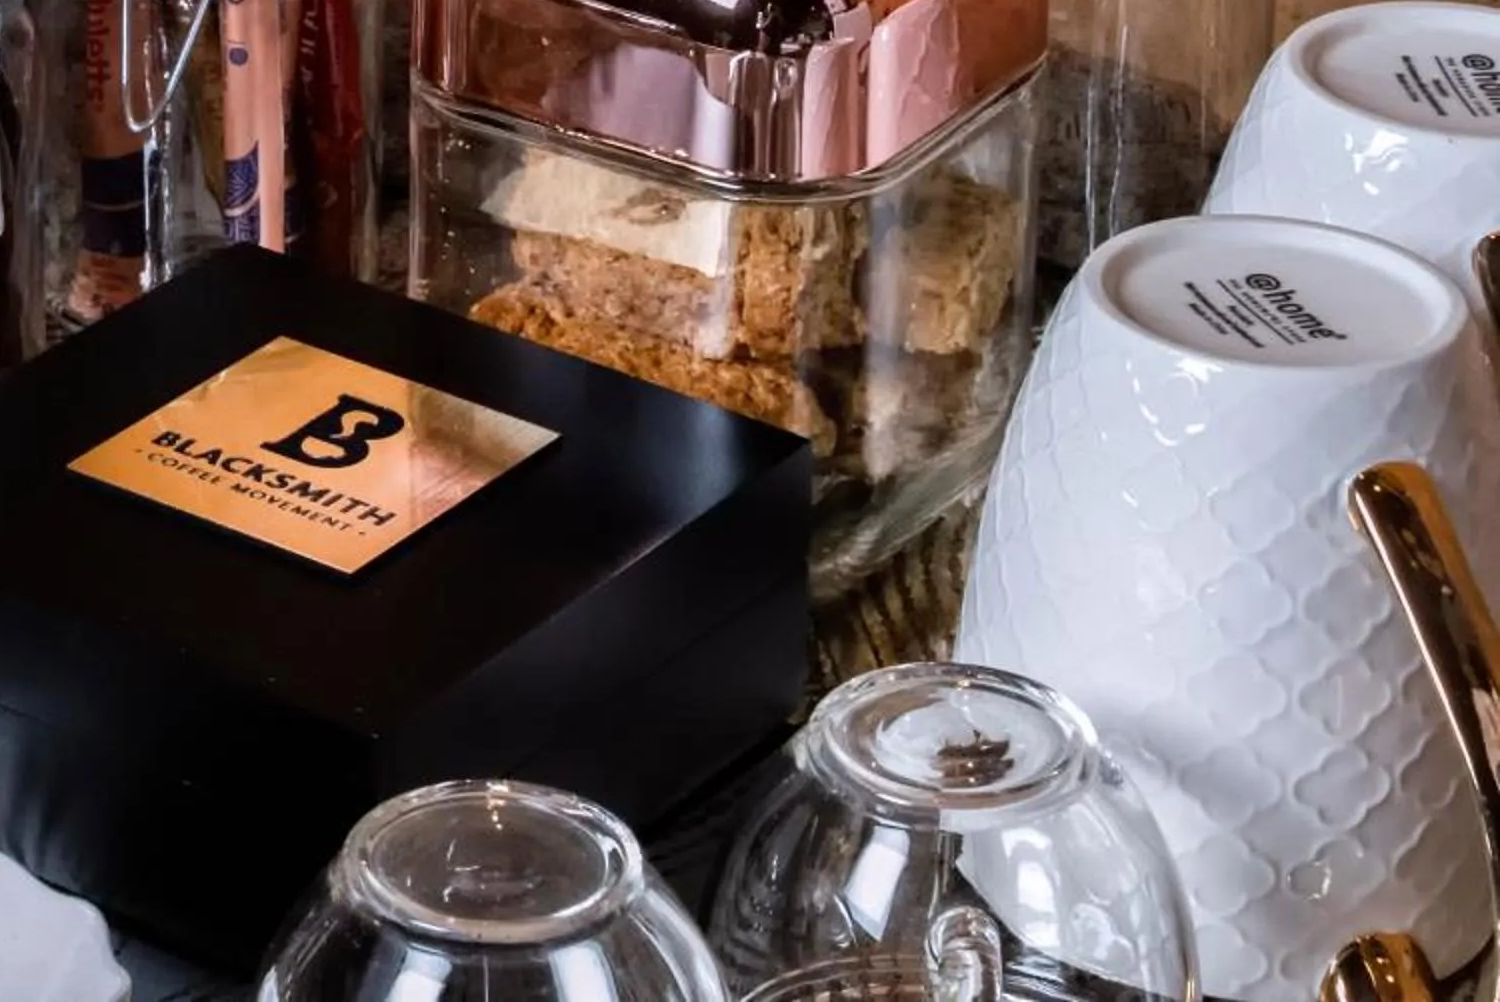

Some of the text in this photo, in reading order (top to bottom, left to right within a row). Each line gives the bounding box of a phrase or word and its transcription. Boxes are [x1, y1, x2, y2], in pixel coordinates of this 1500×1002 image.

[147, 451, 352, 533] COFFEE MOVEMENT
[151, 430, 399, 528] BLACKSMITH
